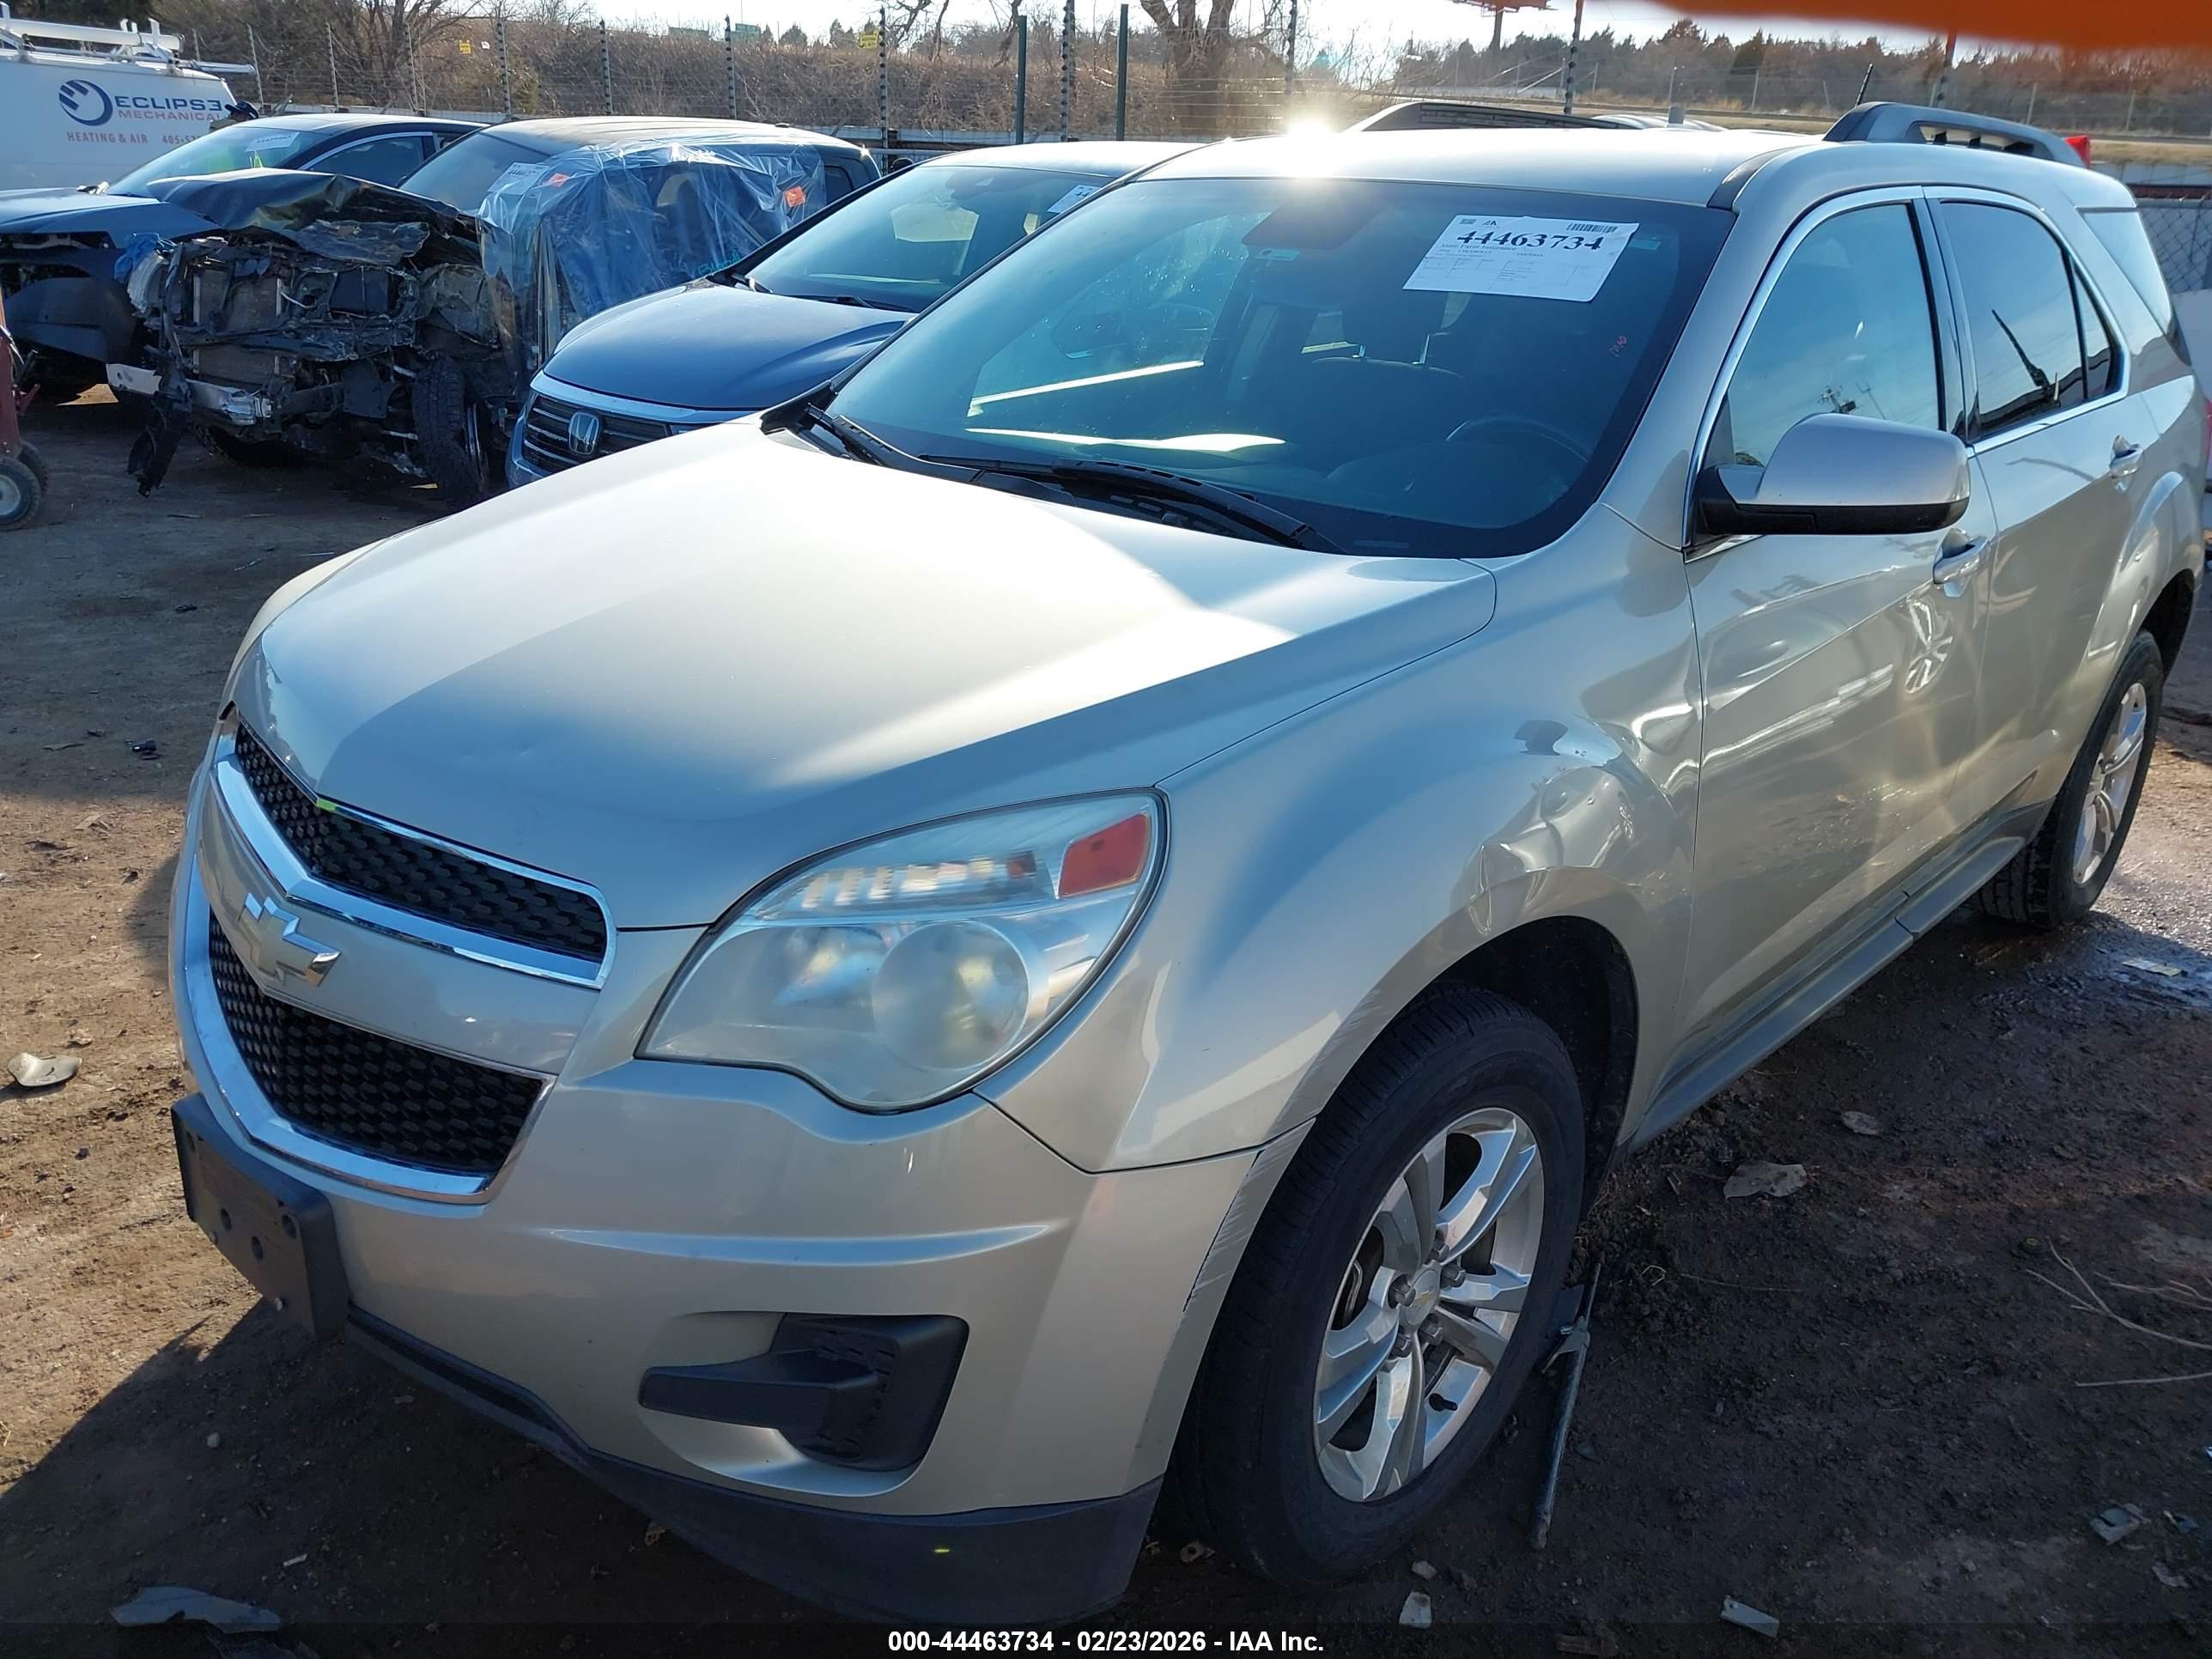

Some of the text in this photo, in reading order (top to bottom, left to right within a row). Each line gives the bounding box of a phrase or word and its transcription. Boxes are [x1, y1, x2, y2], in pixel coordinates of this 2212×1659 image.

[67, 131, 149, 144] HEATING & AIR
[1456, 229, 1604, 251] 44463734
